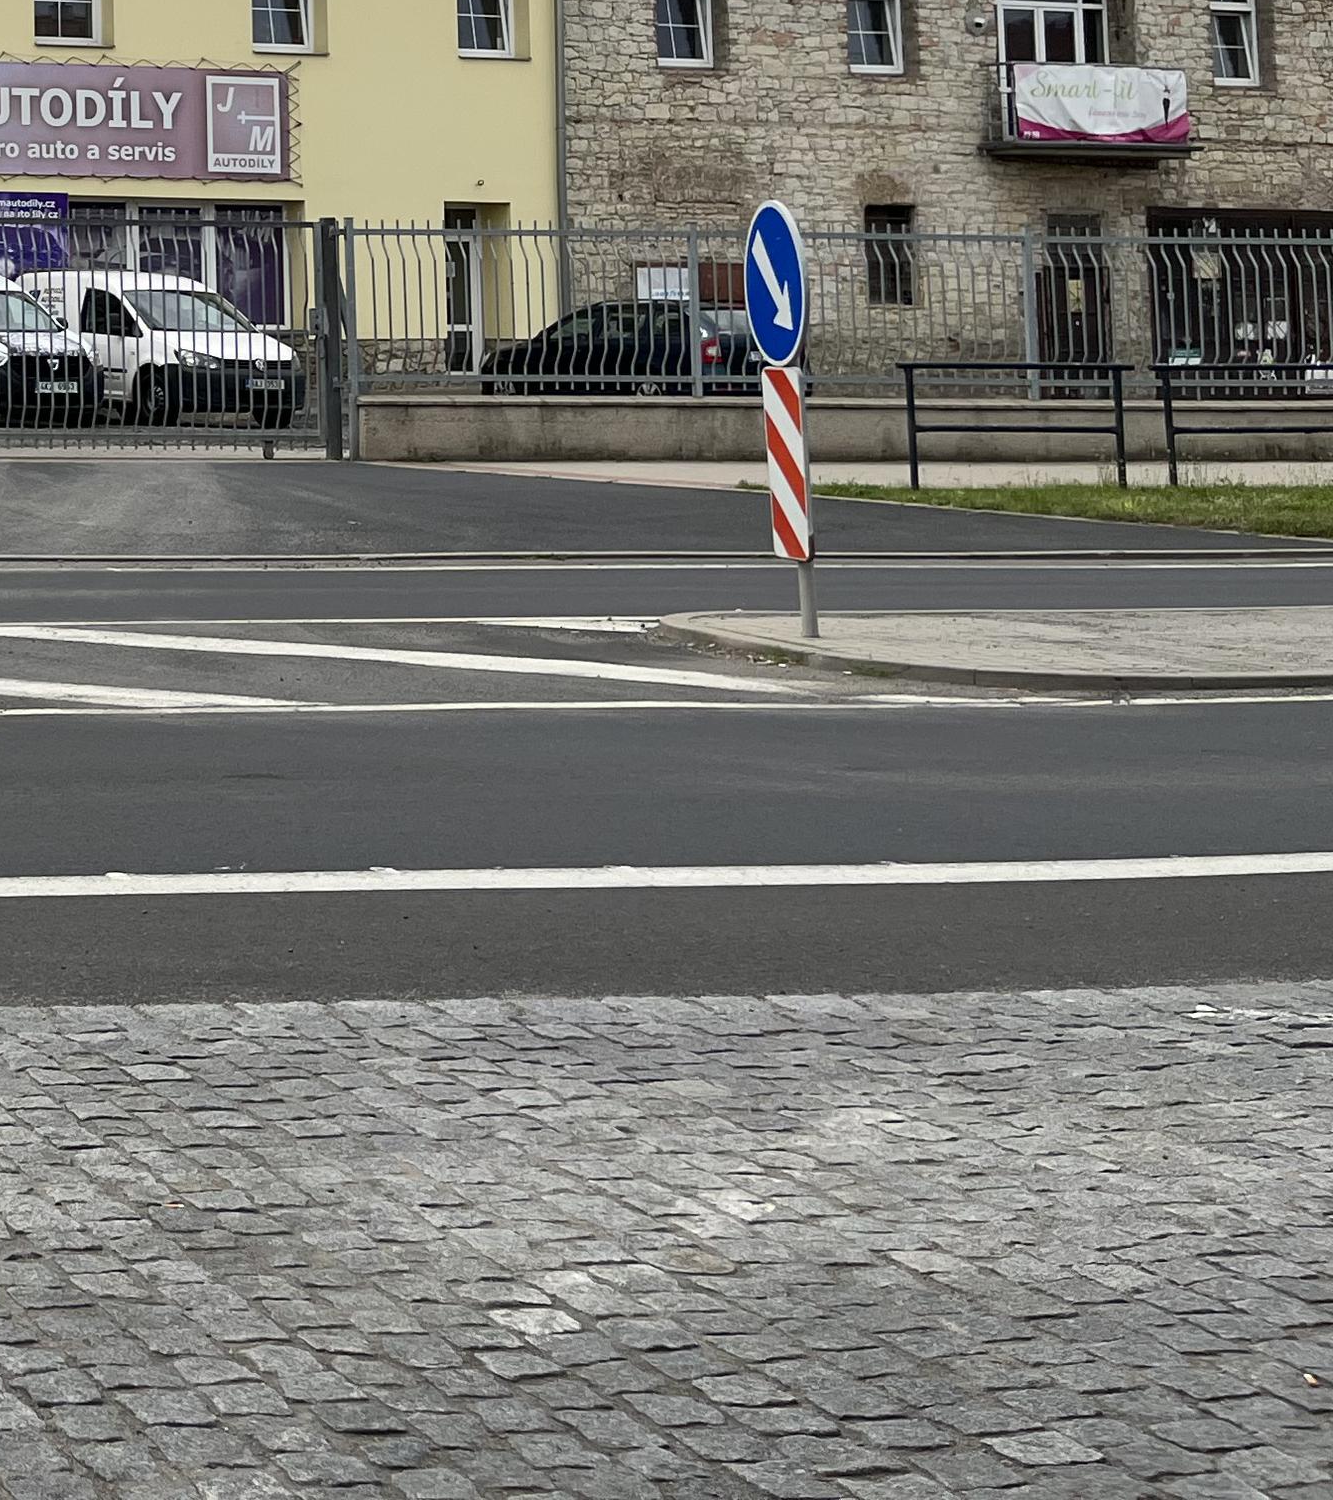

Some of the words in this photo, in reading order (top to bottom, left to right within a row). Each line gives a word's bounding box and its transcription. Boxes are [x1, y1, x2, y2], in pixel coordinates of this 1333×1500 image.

[27, 140, 79, 159] auto
[86, 143, 100, 160] a
[107, 141, 177, 161] servis
[213, 157, 276, 168] AUTODÍLY
